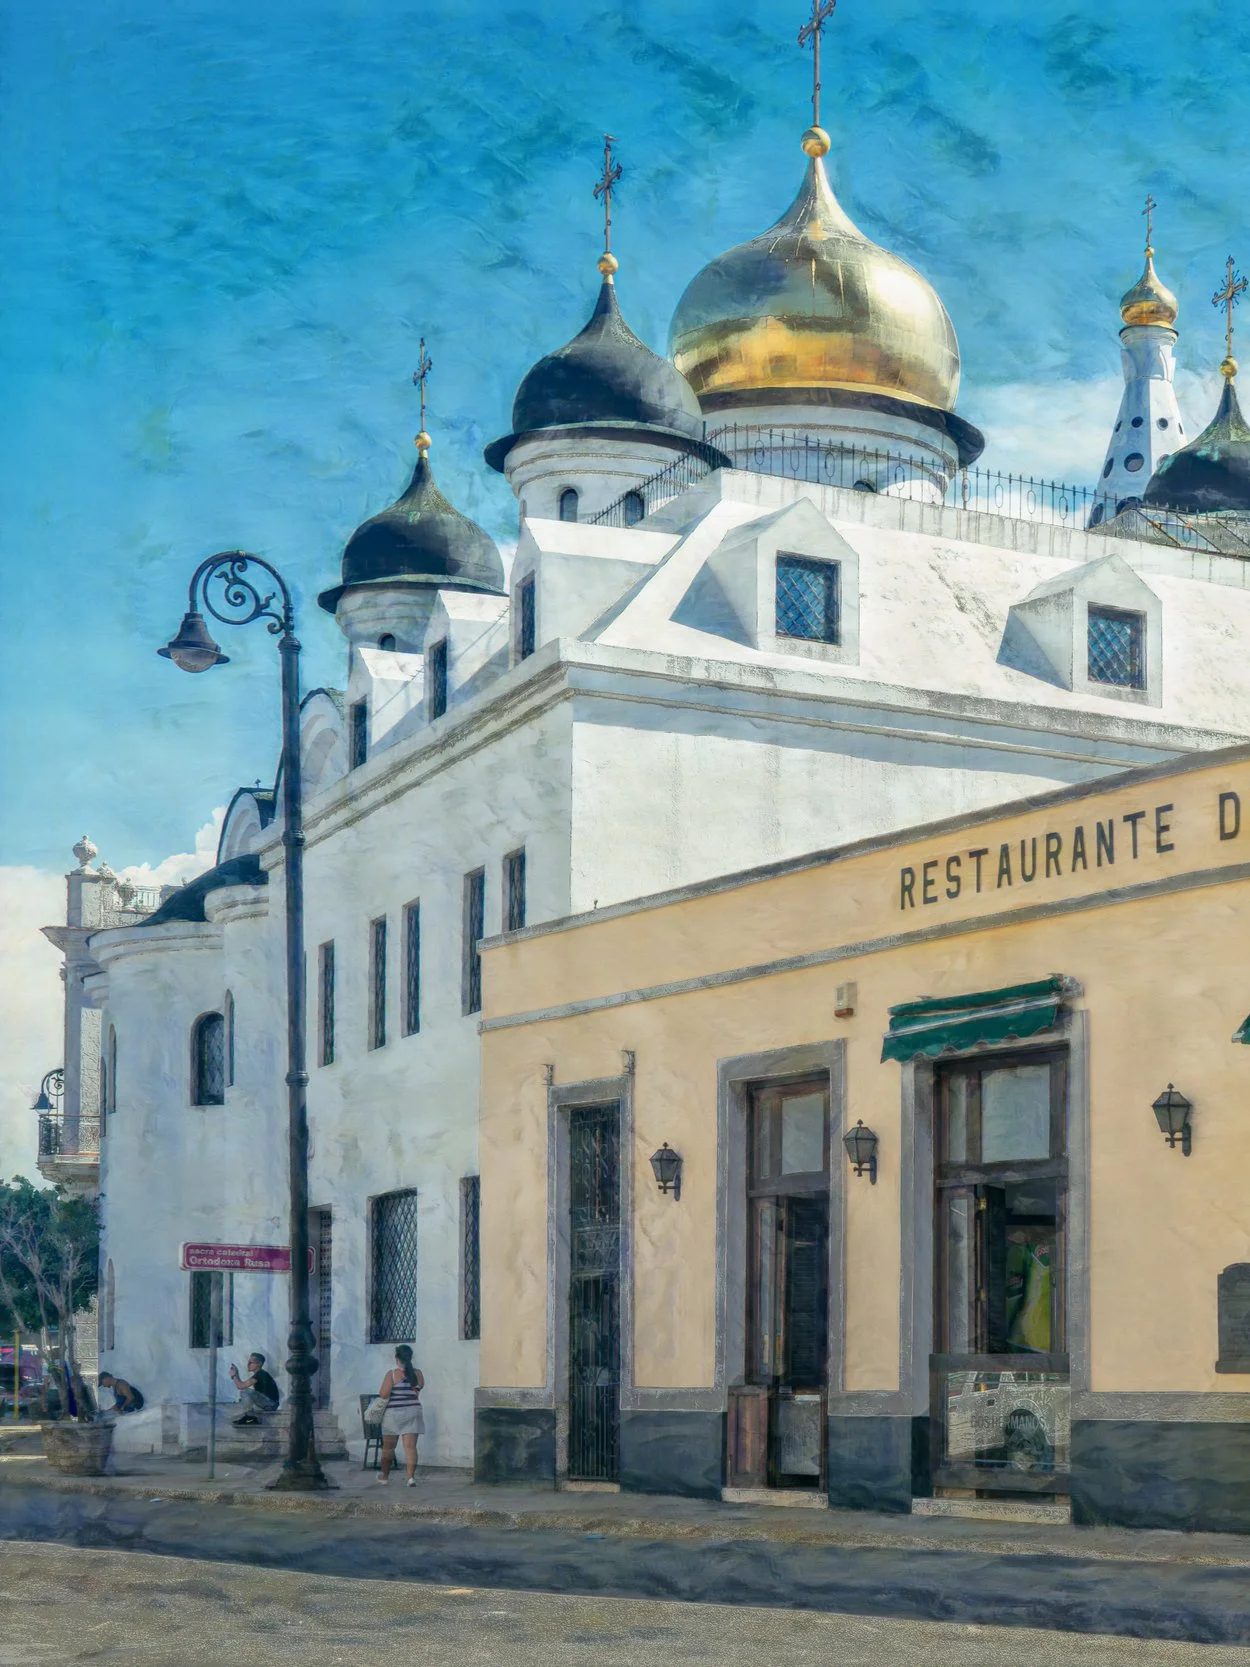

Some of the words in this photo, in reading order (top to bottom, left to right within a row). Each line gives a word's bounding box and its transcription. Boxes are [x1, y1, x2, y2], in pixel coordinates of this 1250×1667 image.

[900, 803, 1175, 911] RESTAURANTE
[189, 1256, 241, 1266] Ortodoxa
[244, 1259, 271, 1268] Rusa
